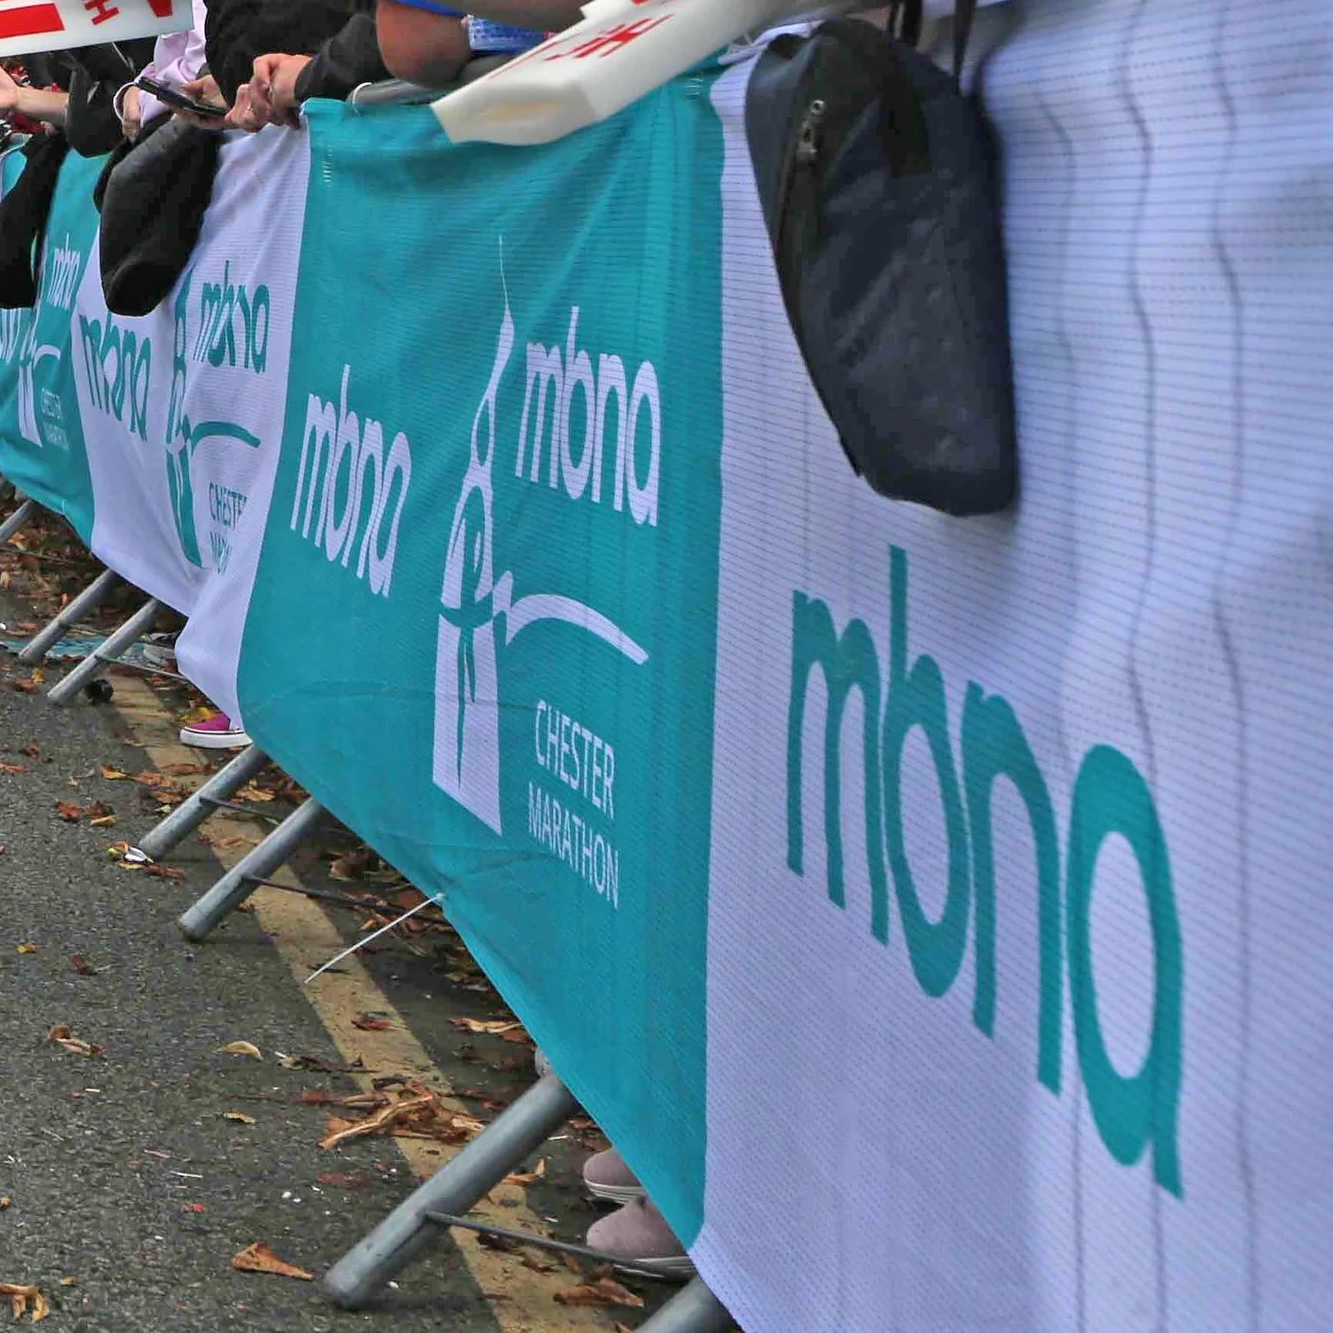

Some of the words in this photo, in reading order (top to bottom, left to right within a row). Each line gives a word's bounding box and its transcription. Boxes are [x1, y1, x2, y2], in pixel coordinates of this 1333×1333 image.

[193, 260, 270, 374] mbna
[290, 363, 412, 600] mbna
[515, 305, 660, 528] mbna
[528, 781, 619, 911] MARATHON
[535, 698, 615, 821] CHESTER
[787, 544, 1184, 1201] mbna
